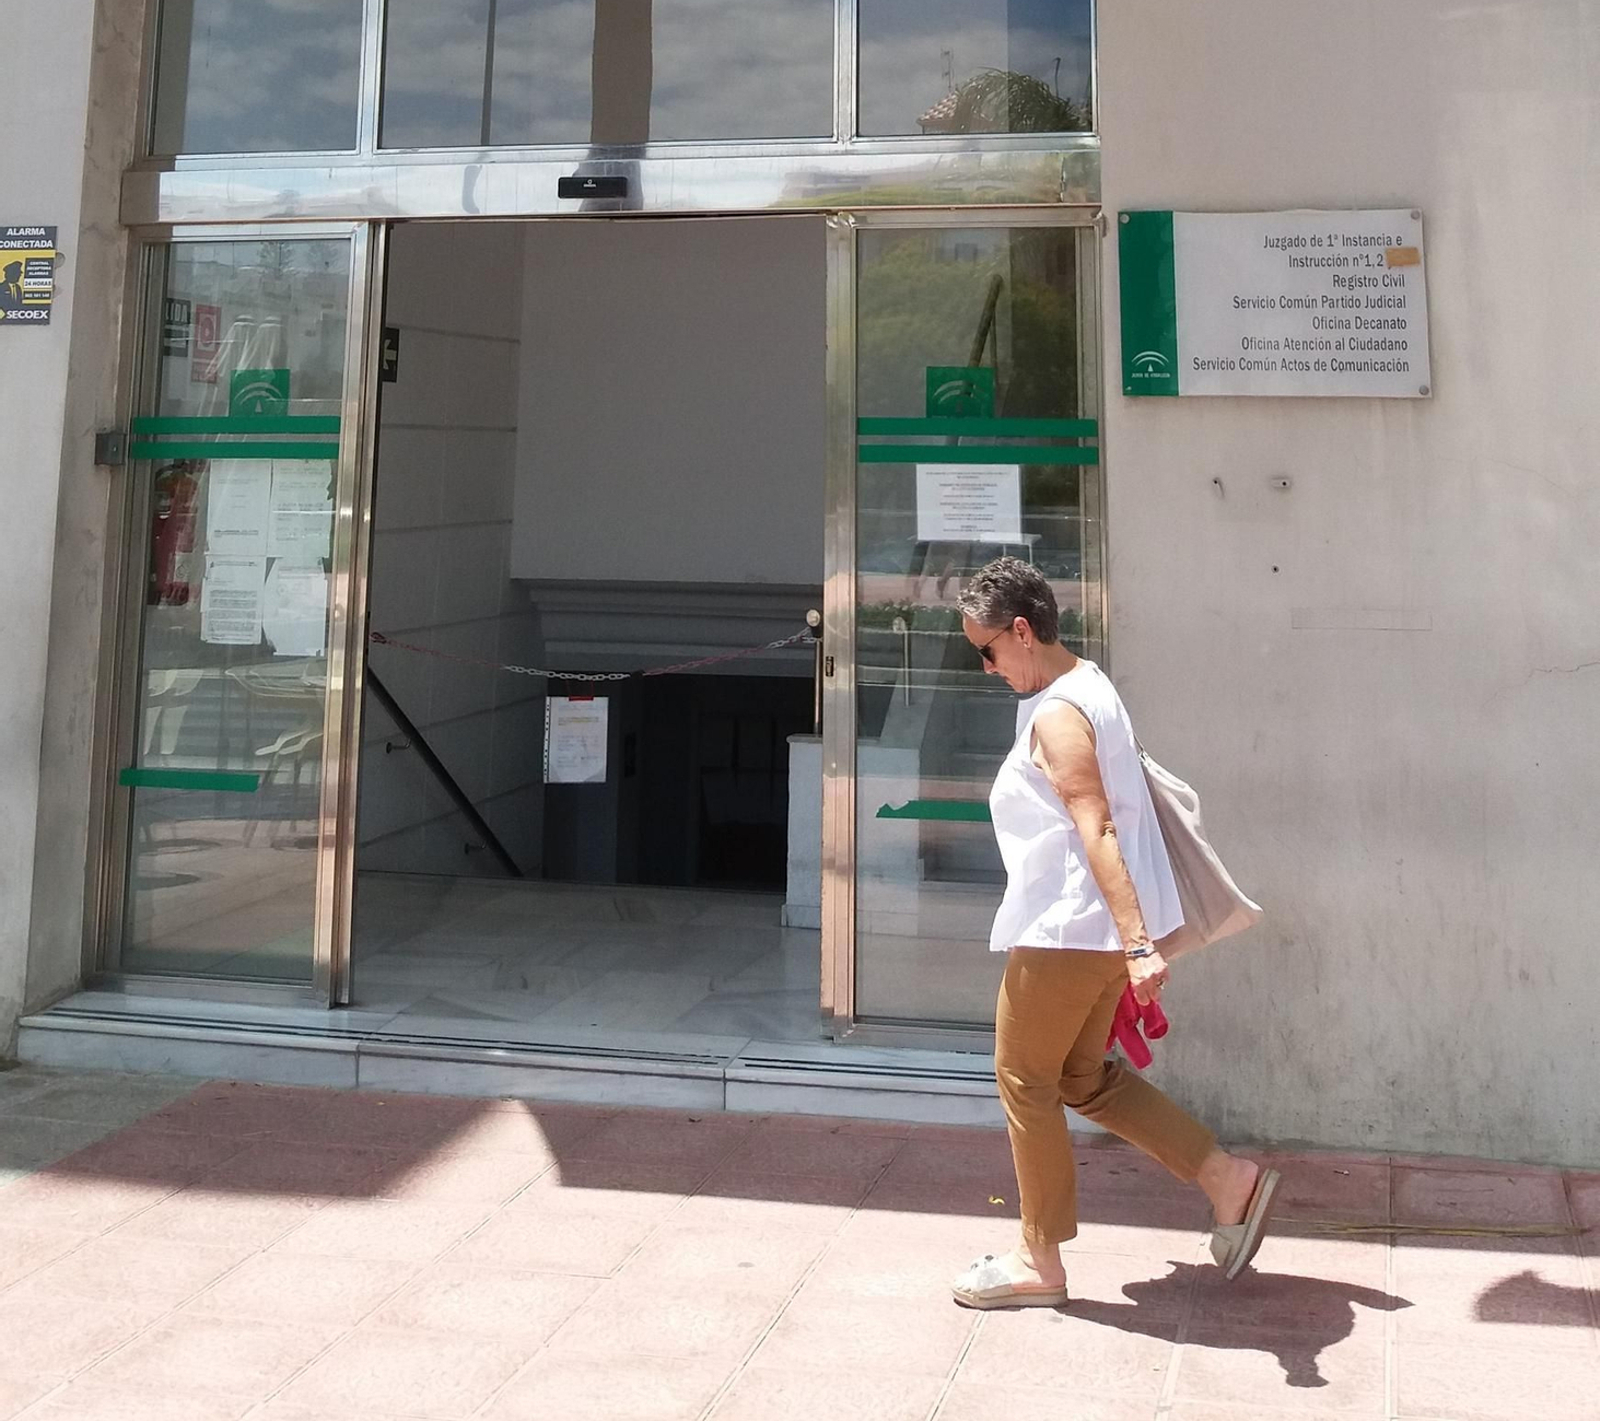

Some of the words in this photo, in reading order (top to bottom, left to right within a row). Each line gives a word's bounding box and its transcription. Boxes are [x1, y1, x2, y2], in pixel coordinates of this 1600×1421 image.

[6, 227, 46, 236] ALARMA
[0, 239, 53, 249] CONECTADA
[1263, 235, 1307, 251] Juzgado
[1310, 234, 1323, 247] de
[1342, 233, 1392, 247] Instancia
[1395, 235, 1403, 247] e
[1288, 253, 1349, 268] Instrucción
[1332, 274, 1378, 291] Registro
[1381, 273, 1405, 288] Civil
[1232, 295, 1276, 310] Servicio
[1279, 295, 1318, 310] Común
[1321, 295, 1362, 310] Partido
[1365, 295, 1406, 310] Judicial
[6, 310, 48, 319] SECOEX
[1312, 316, 1351, 330] Oficina
[1354, 316, 1408, 330] Decanato
[1241, 336, 1280, 351] Oficina
[1283, 336, 1332, 351] Atención
[1335, 337, 1345, 351] al
[1349, 337, 1408, 351] Ciudadano
[1192, 357, 1236, 371] Servicio
[1238, 357, 1277, 372] Común
[1280, 357, 1311, 372] Actos
[1313, 358, 1327, 372] de
[1330, 357, 1410, 373] Comunicación
